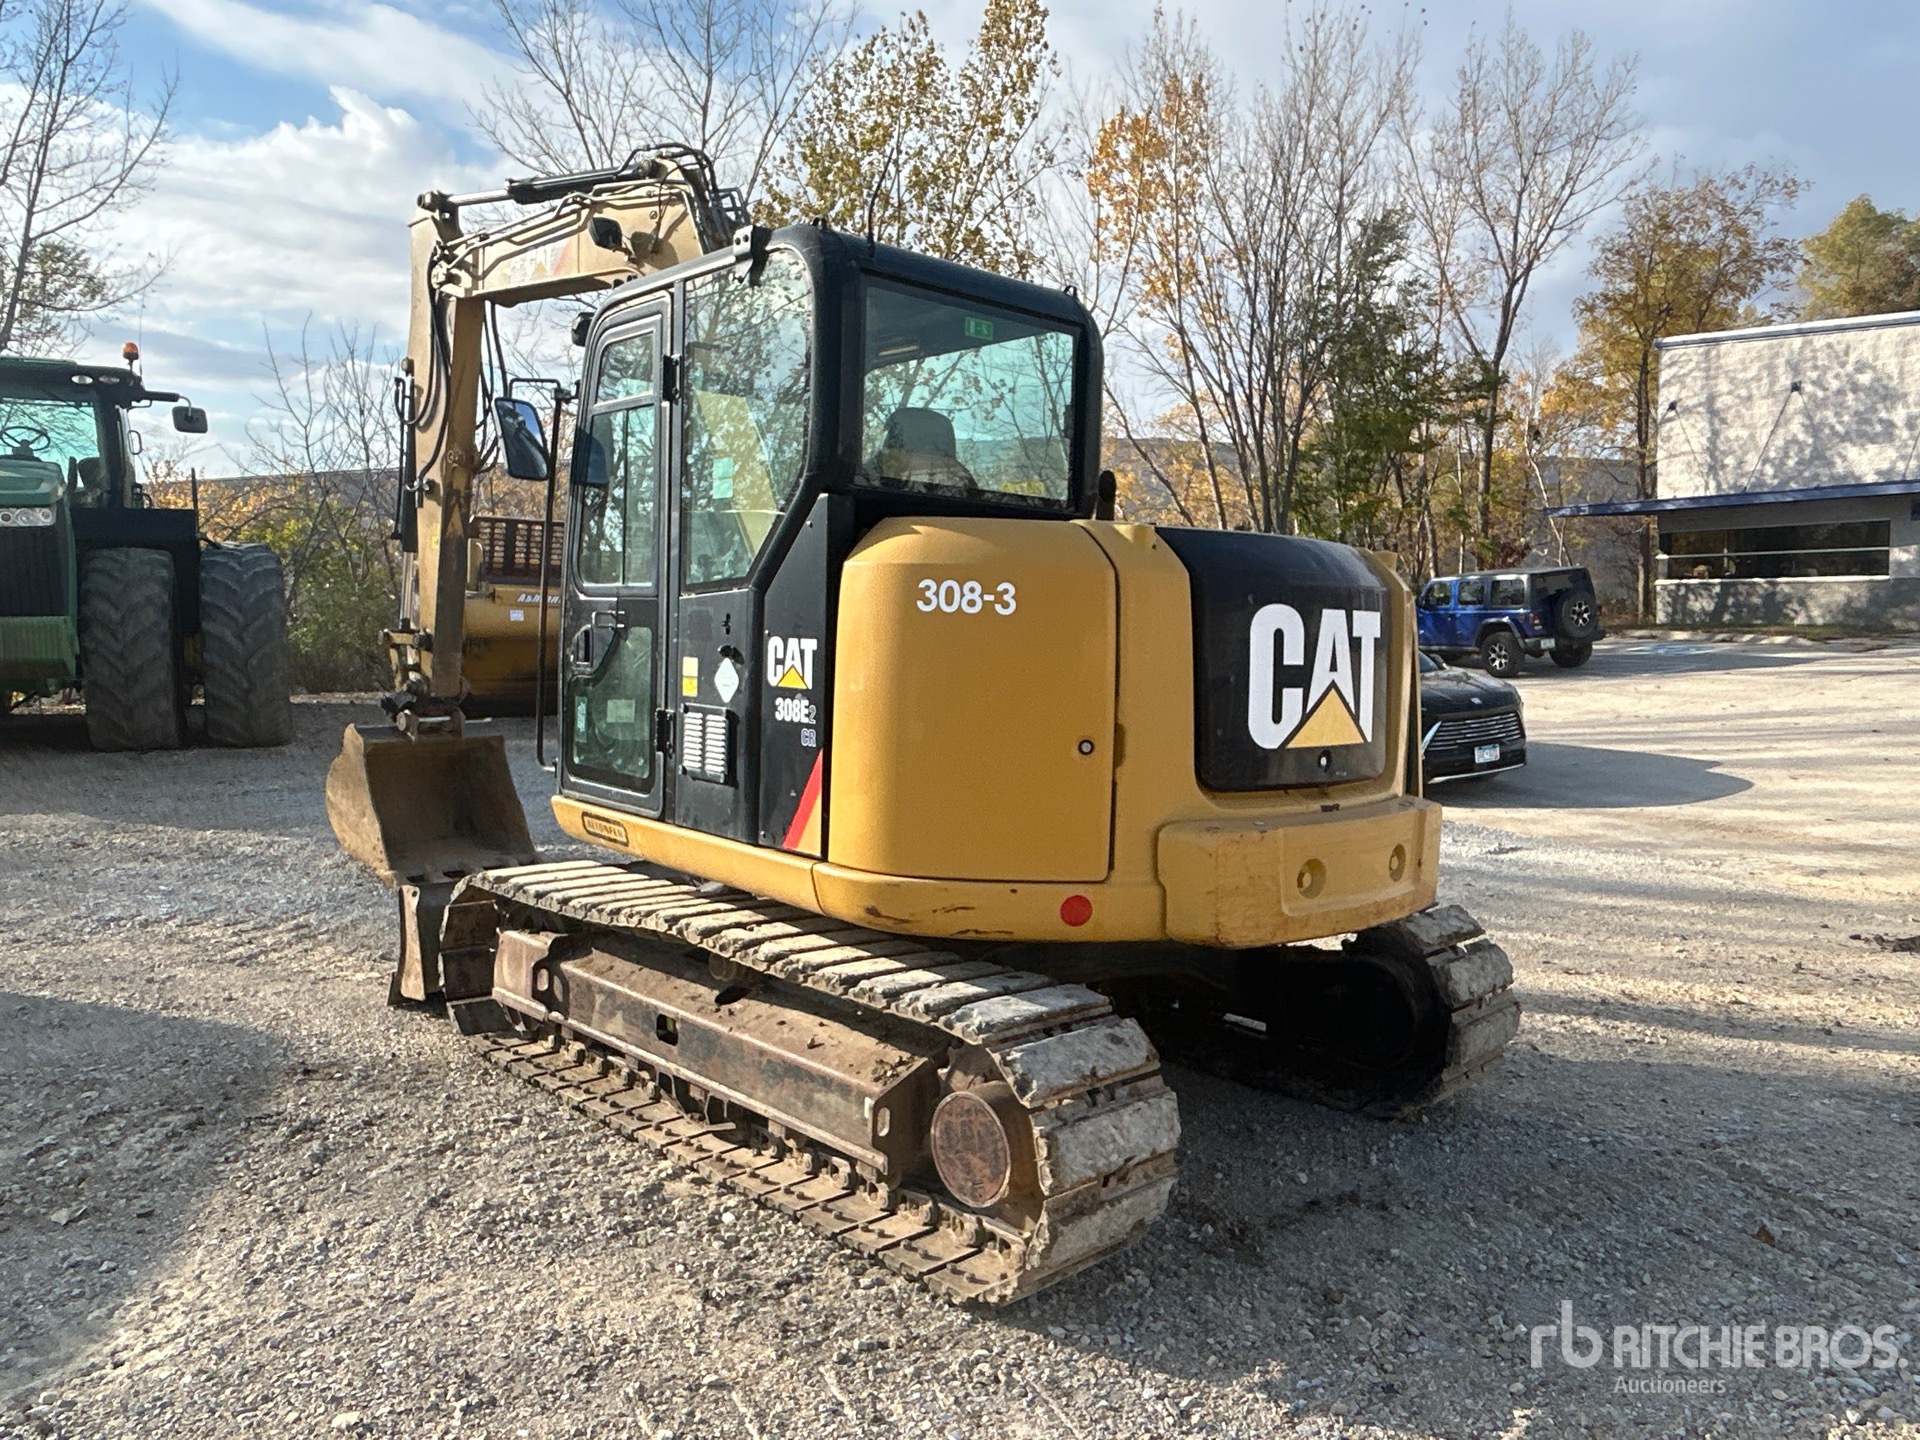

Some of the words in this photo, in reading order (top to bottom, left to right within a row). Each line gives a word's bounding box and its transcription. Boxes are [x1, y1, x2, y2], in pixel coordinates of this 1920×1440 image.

[916, 578, 1017, 616] 308-3
[767, 636, 818, 690] CAT
[1248, 603, 1381, 749] CAT
[800, 728, 817, 748] CR
